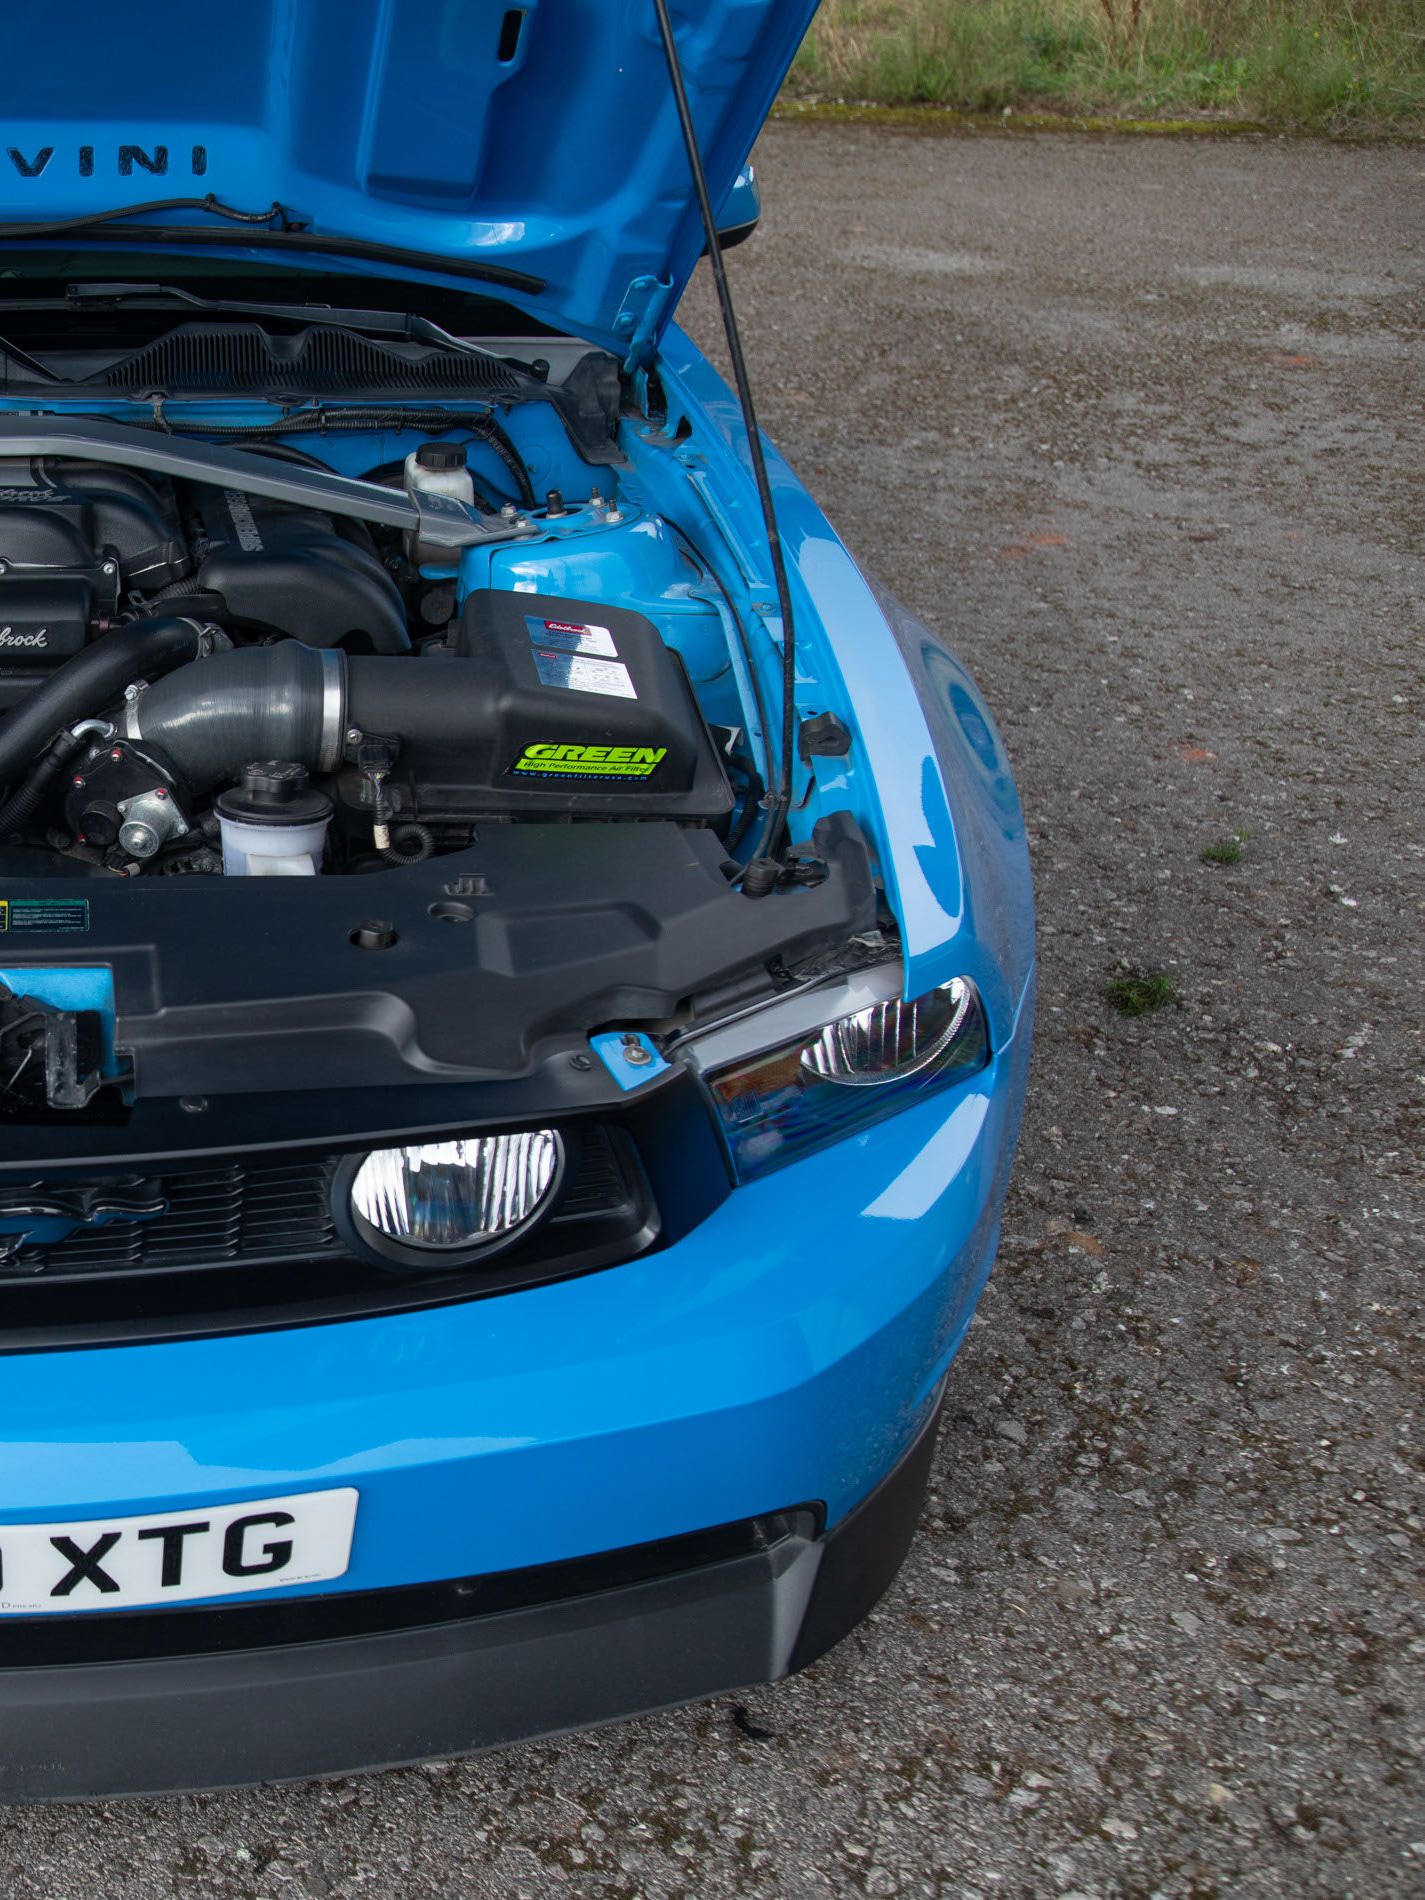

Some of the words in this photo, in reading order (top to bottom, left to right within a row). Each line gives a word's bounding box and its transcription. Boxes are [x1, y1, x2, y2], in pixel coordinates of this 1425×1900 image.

[525, 744, 668, 763] GREEN
[523, 761, 551, 769] High
[548, 762, 607, 772] Performance
[625, 765, 649, 773] Filter
[49, 1511, 296, 1597] XTG
